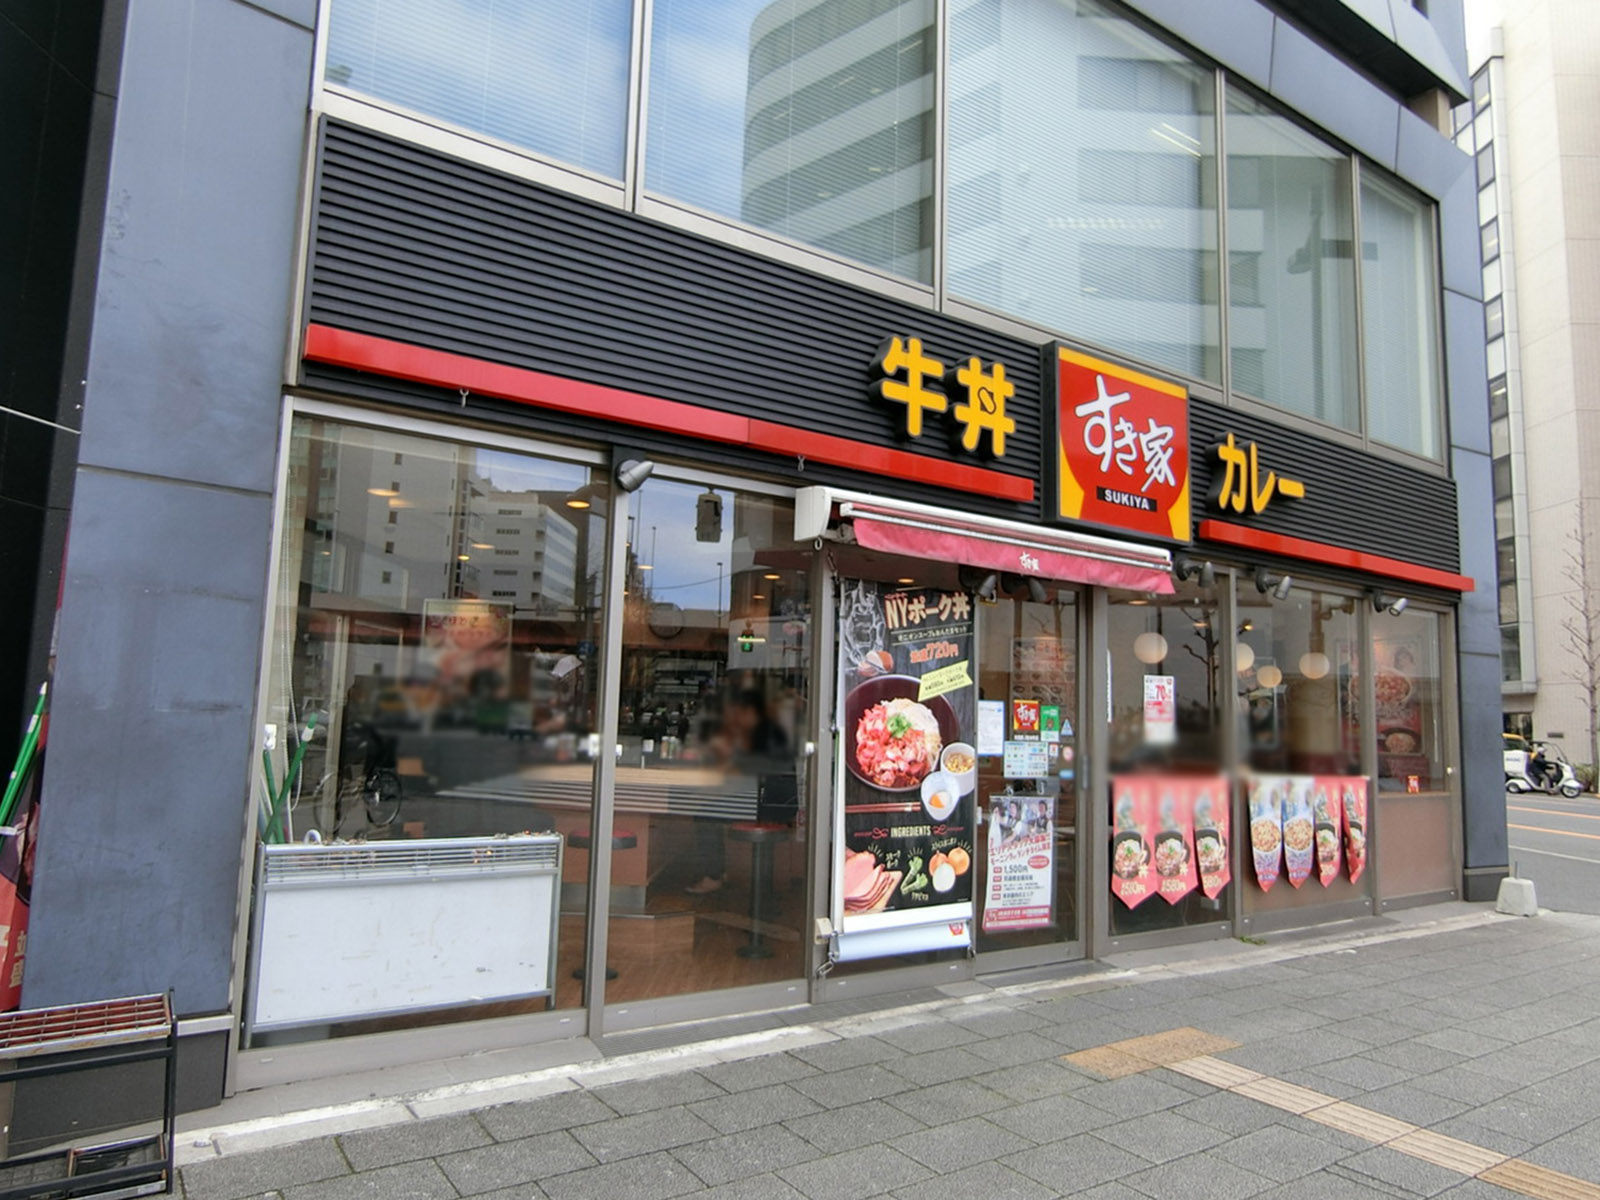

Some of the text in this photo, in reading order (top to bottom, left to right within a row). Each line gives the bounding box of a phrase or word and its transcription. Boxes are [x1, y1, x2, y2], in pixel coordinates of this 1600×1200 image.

[880, 335, 1016, 458] 牛丼
[1074, 374, 1177, 493] すき家
[1104, 489, 1150, 510] SUKIYA
[1217, 431, 1306, 515] カレー
[884, 591, 971, 630] NYポーク丼
[890, 825, 931, 838] INGREDIENTS
